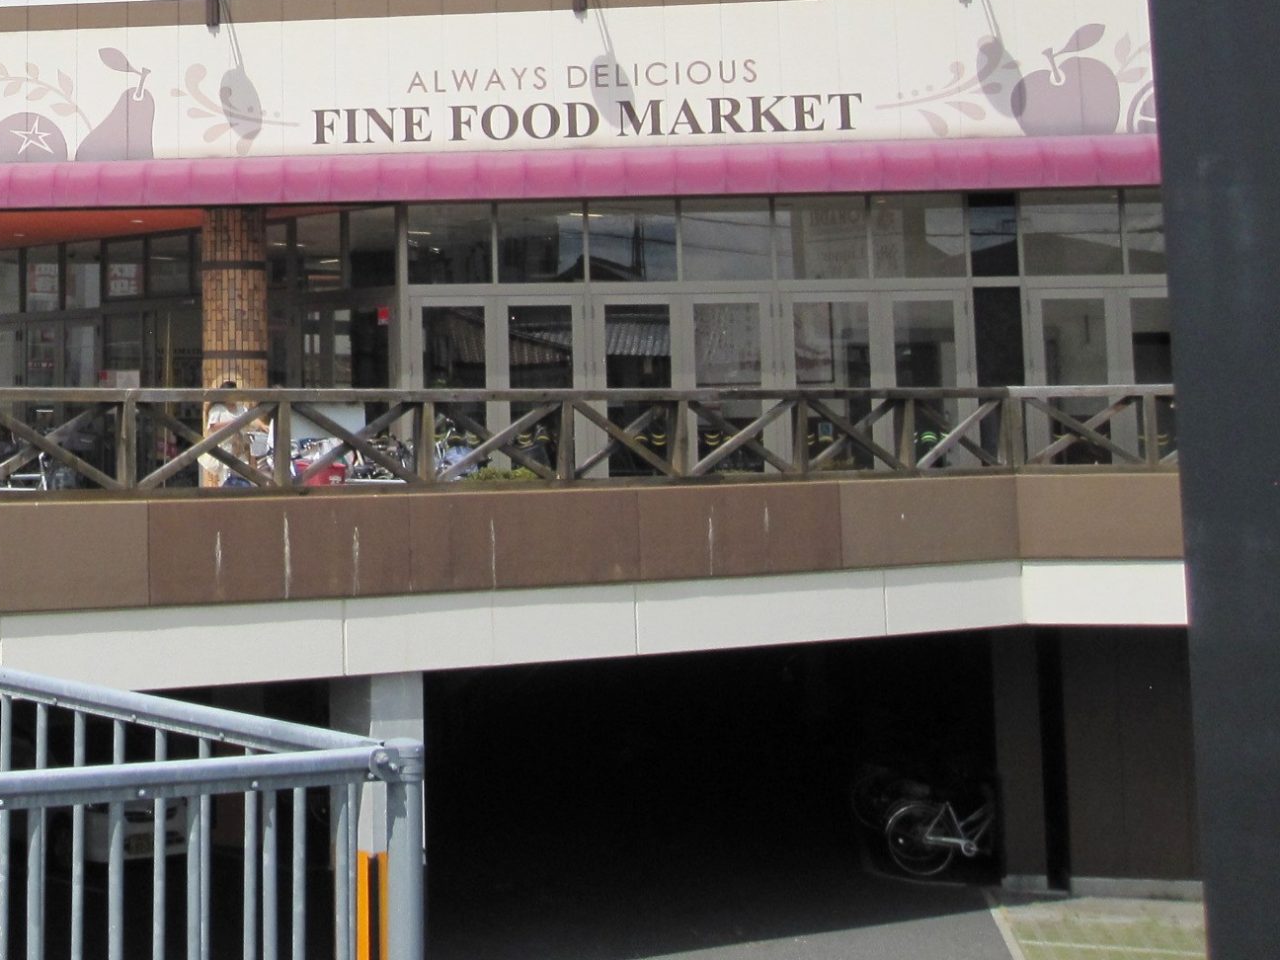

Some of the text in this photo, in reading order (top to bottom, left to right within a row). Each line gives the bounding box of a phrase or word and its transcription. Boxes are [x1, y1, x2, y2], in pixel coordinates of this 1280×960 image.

[407, 59, 759, 94] ALWAYS DELICIOUS
[312, 93, 863, 145] FINE FOOD MARKET
